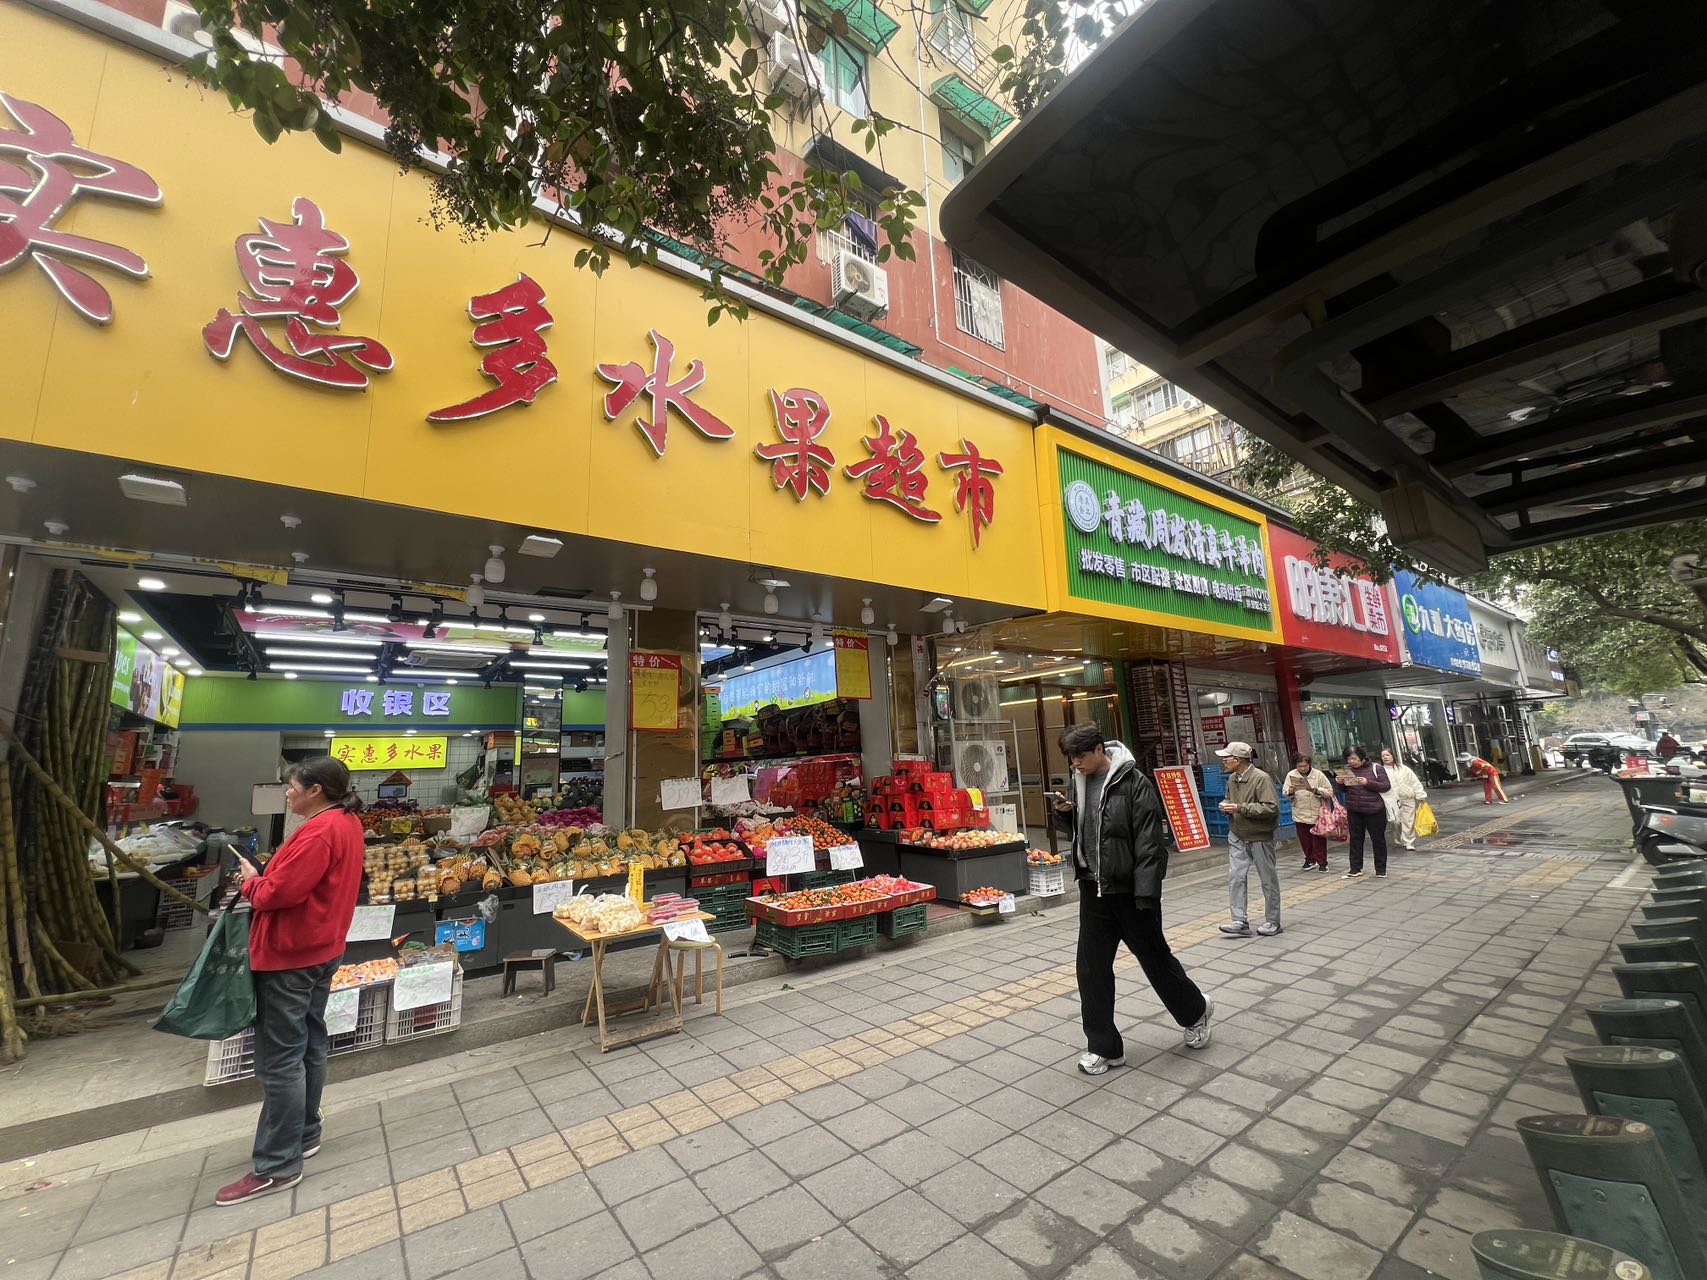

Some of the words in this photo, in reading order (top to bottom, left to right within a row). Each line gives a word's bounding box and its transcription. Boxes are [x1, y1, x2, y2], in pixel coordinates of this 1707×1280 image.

[1079, 548, 1126, 579] 批发零售
[1284, 555, 1368, 632] 明康汇
[835, 638, 855, 648] 特价
[632, 654, 661, 667] 特价
[341, 688, 452, 717] 收银区
[337, 743, 443, 765] 实惠多水果
